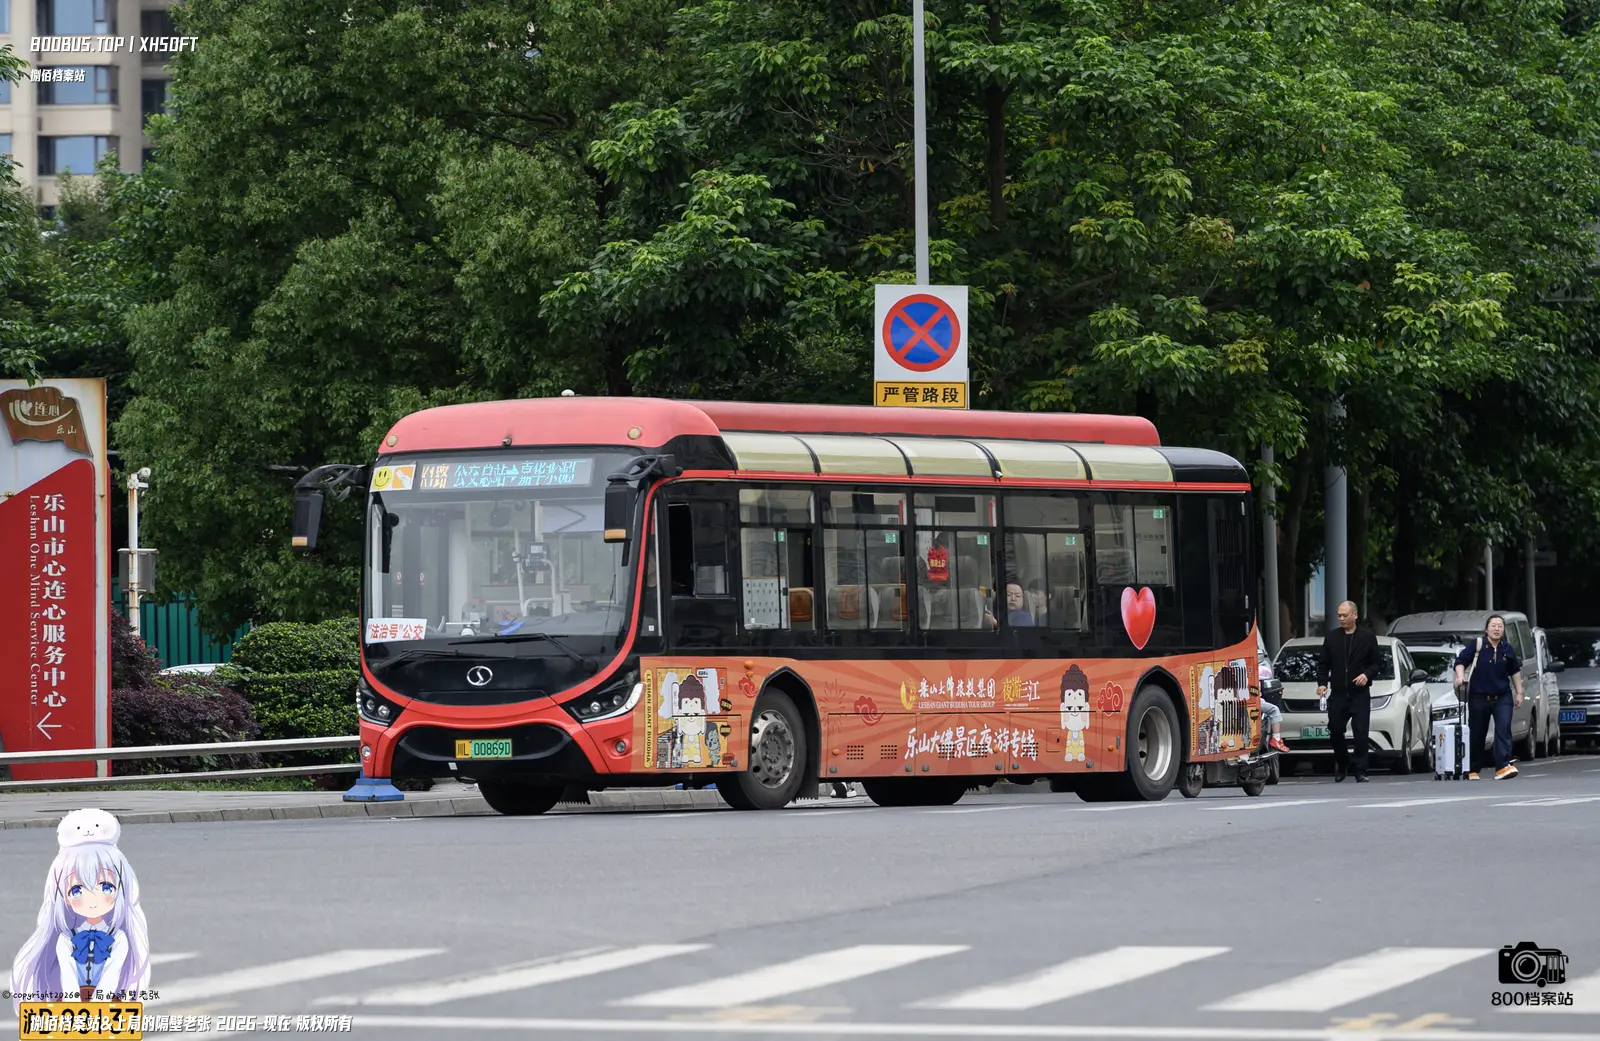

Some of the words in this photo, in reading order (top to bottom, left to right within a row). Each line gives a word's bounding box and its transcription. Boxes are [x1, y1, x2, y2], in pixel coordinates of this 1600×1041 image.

[34, 401, 60, 417] 连心
[882, 386, 959, 404] 严管路段
[56, 424, 77, 435] 乐山
[30, 495, 40, 540] Leshan
[30, 543, 40, 569] One
[30, 574, 40, 607] Mind
[42, 493, 67, 708] 乐山市心连心服务中心
[30, 612, 40, 659] Service
[30, 663, 40, 707] Center
[904, 723, 1037, 761] 乐山大佛景区夜游专线
